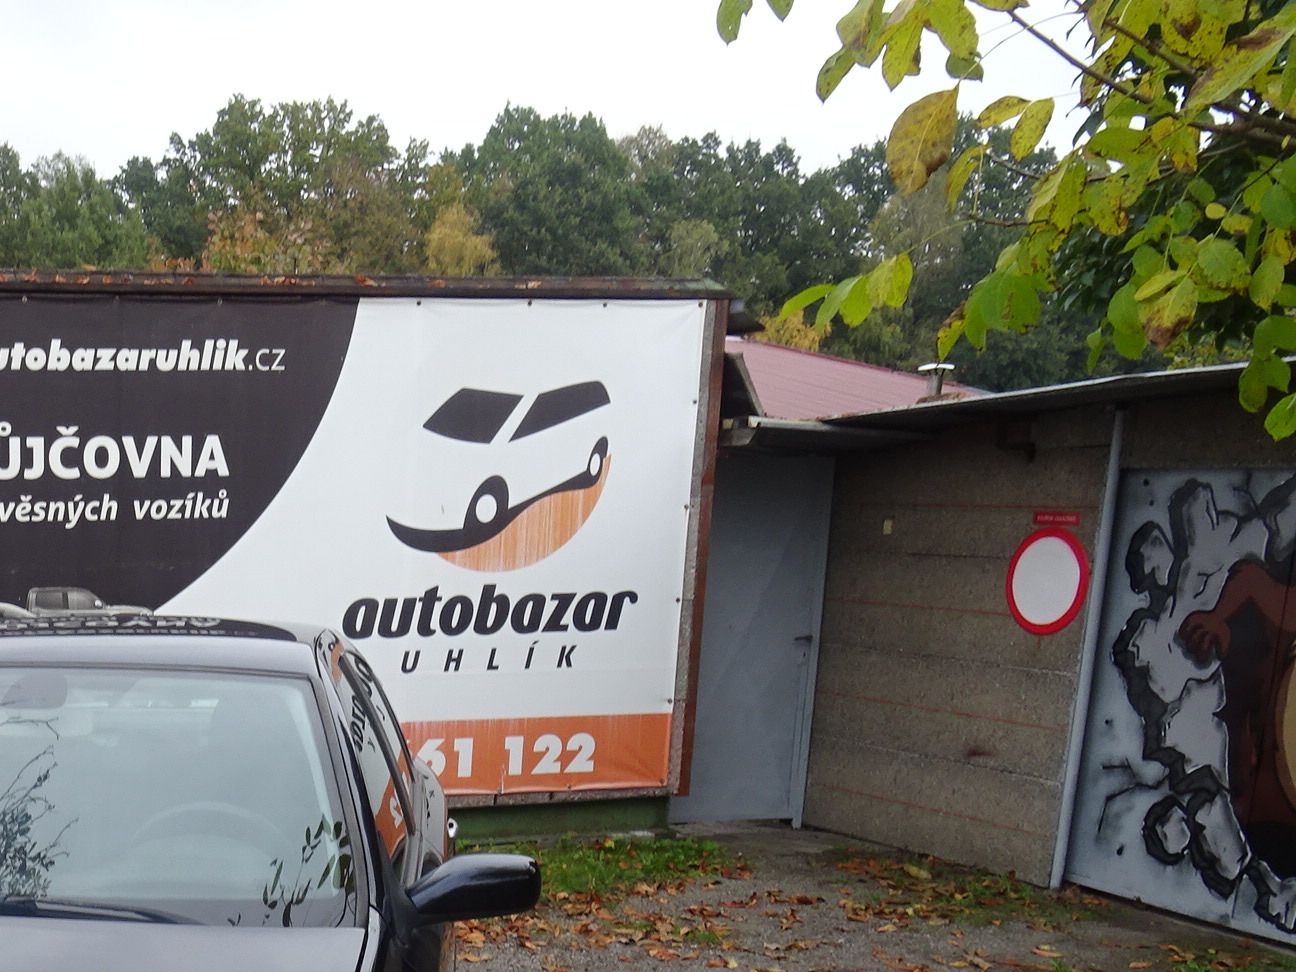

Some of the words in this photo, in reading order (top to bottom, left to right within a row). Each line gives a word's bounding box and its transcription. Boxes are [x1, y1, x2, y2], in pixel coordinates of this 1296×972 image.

[133, 489, 229, 520] vozíků
[342, 584, 638, 640] autobazar
[504, 732, 596, 776] 122
